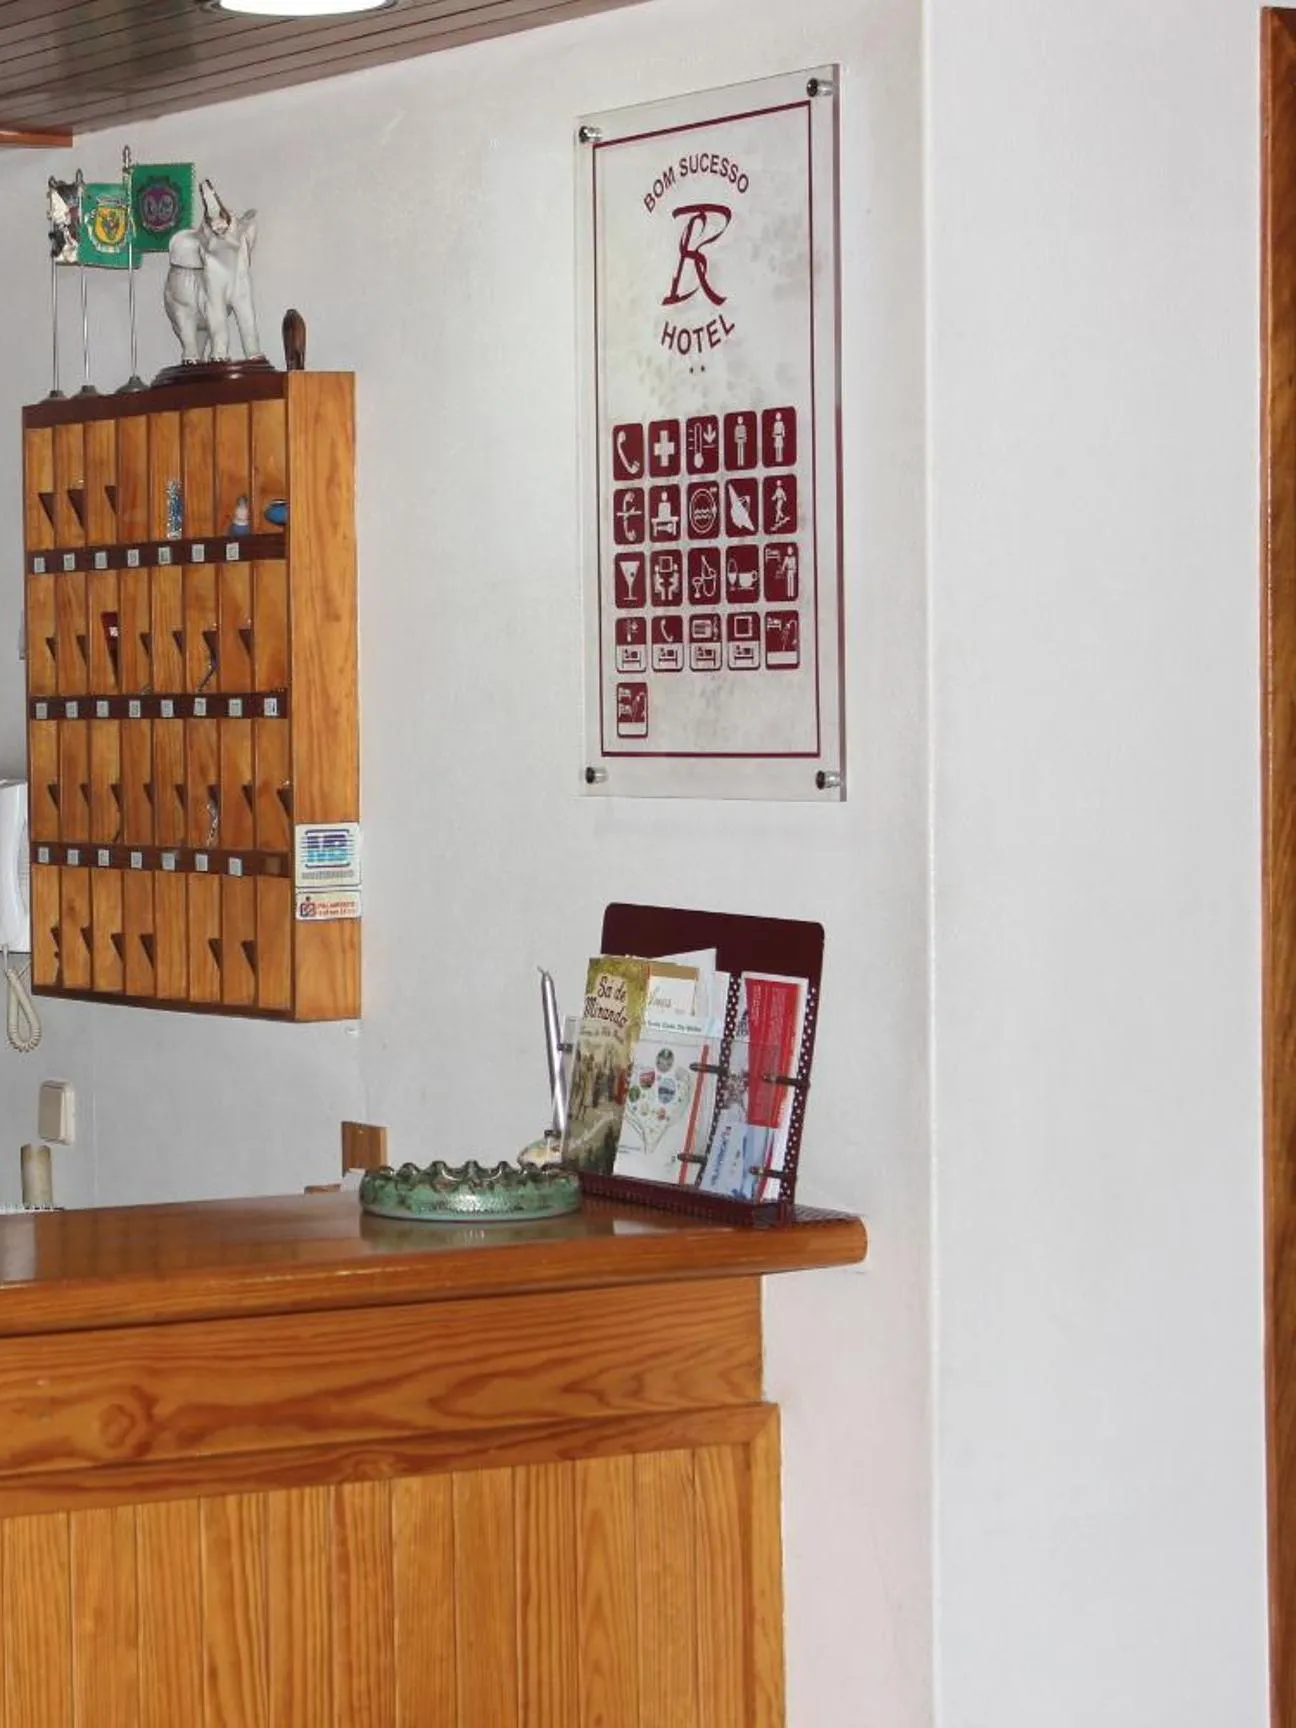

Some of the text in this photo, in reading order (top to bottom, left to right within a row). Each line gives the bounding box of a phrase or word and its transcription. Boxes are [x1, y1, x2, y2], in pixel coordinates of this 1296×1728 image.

[643, 152, 750, 213] BOM SUCESSO
[660, 314, 735, 355] HOTEL
